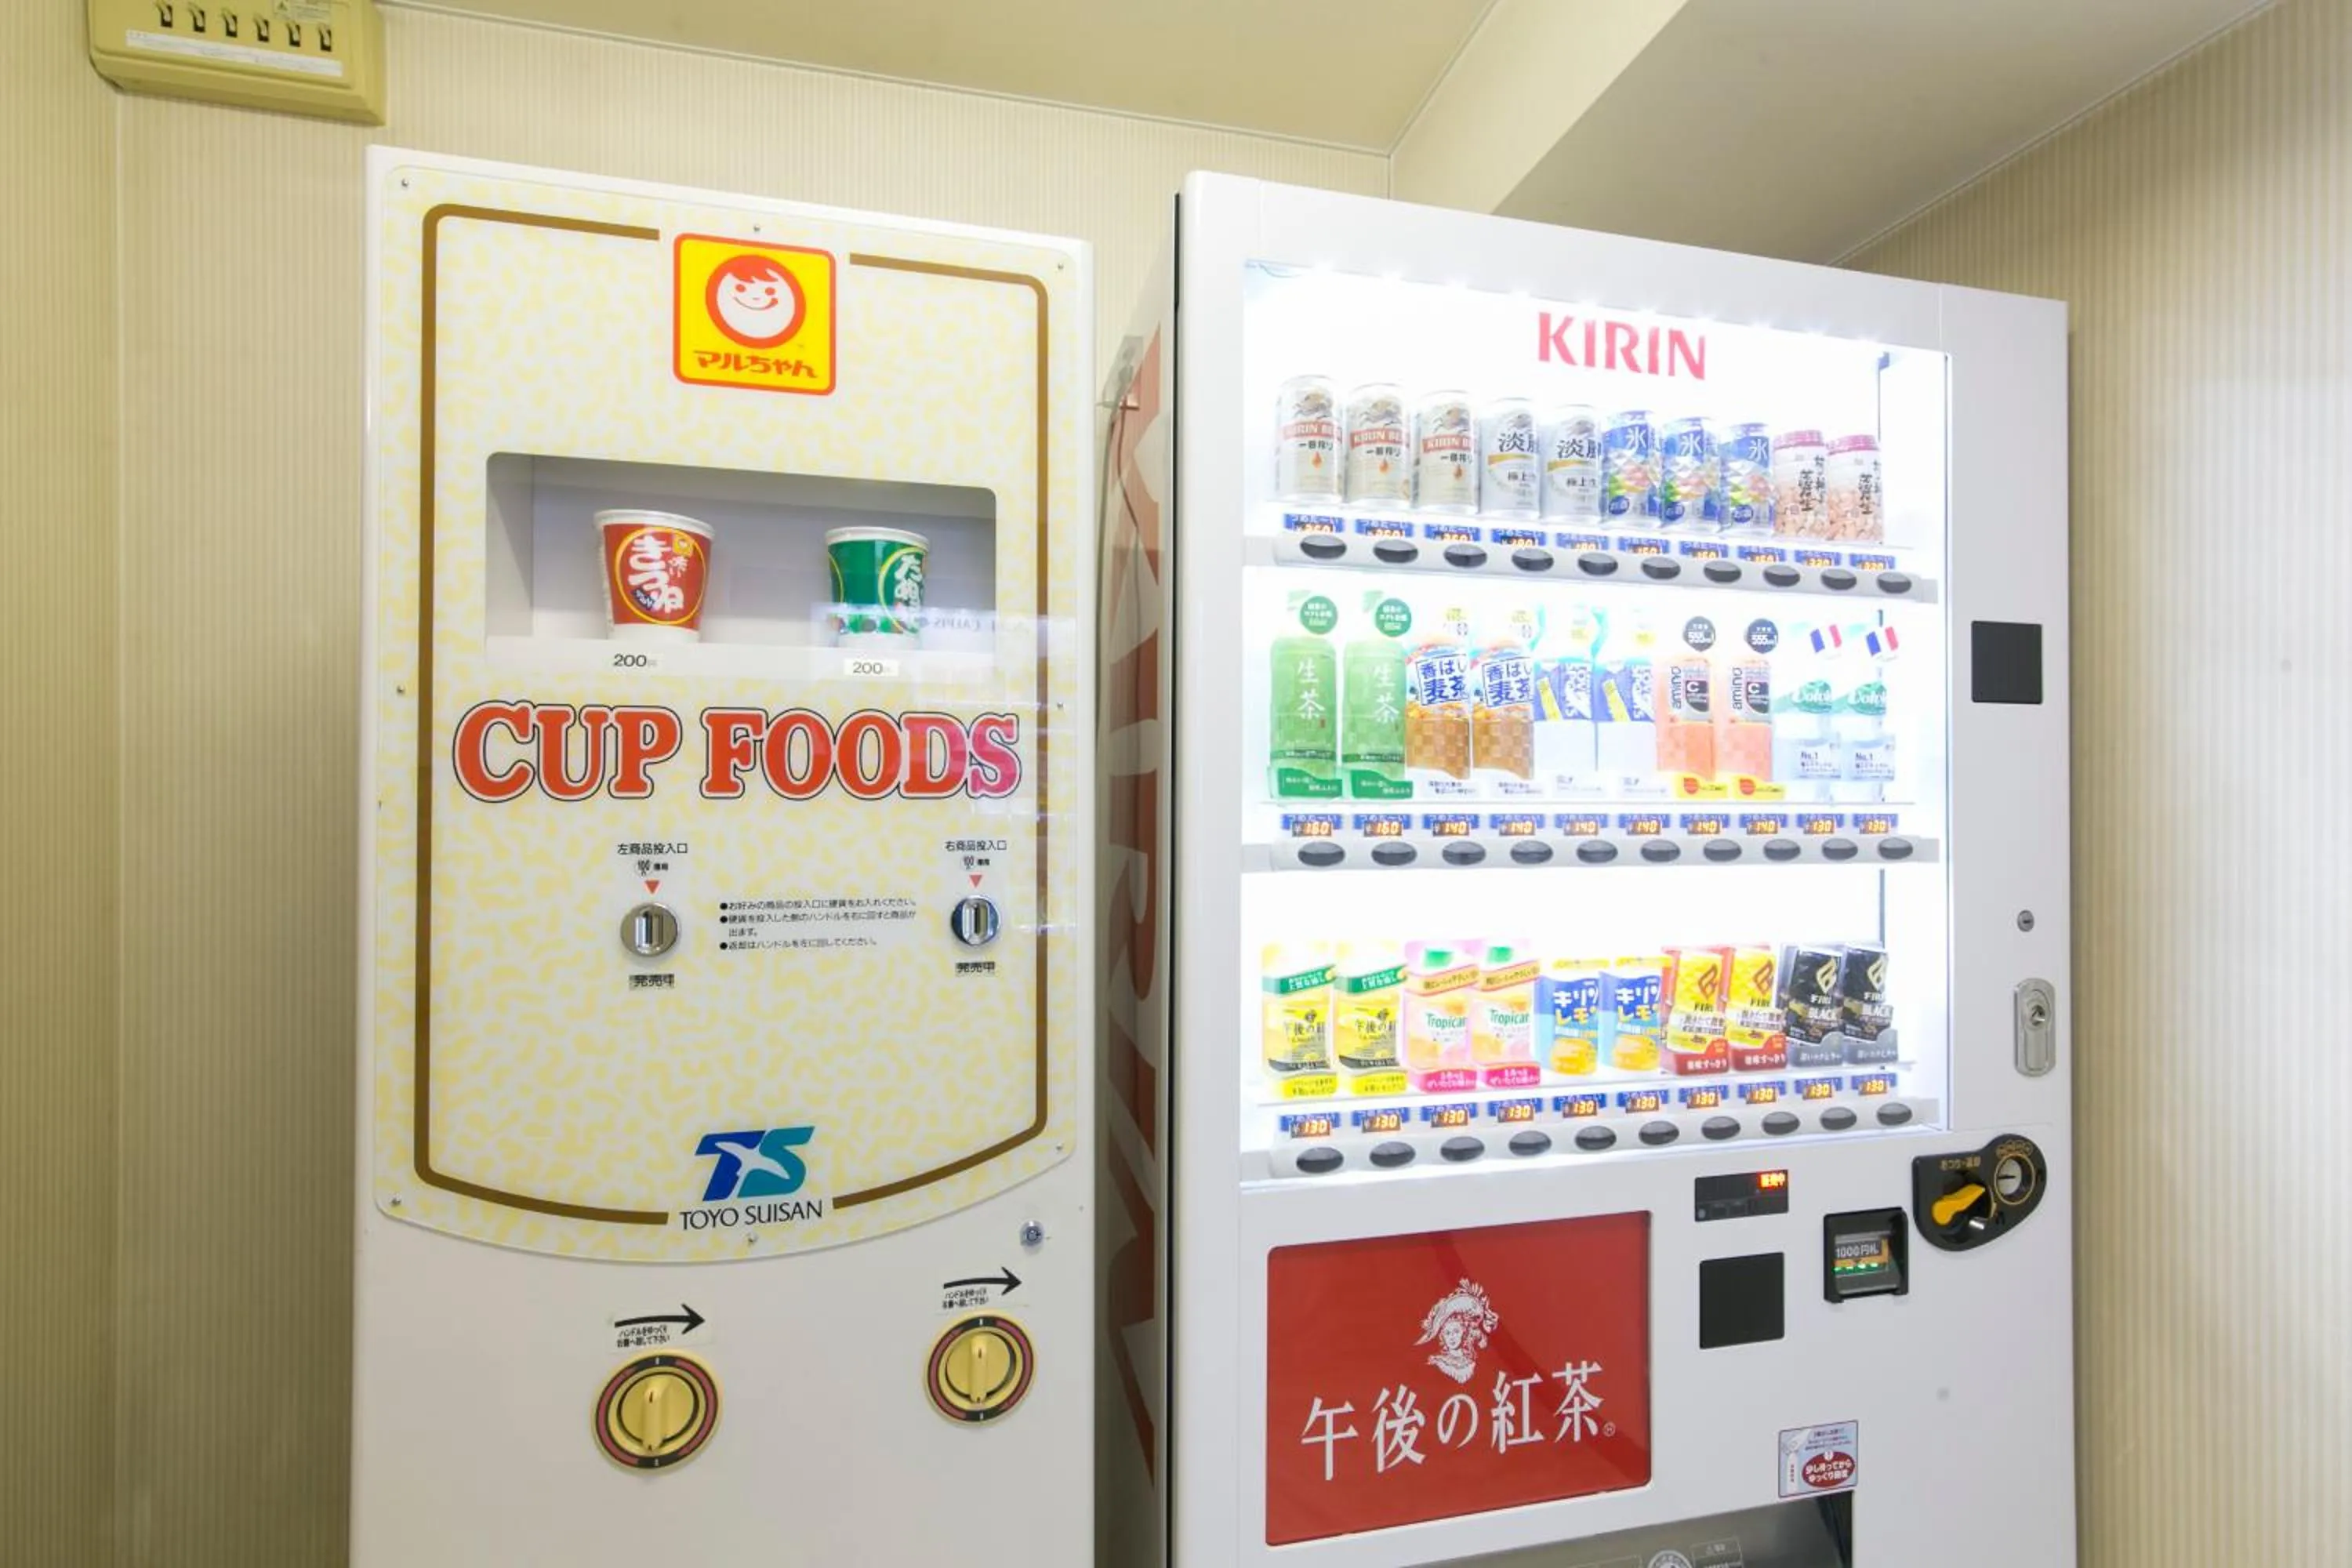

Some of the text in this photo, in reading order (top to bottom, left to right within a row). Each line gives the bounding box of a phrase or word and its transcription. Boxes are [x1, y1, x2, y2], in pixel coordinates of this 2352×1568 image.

[693, 350, 818, 378] マルちゃん
[1538, 312, 1706, 380] KIRIN
[1428, 438, 1461, 448] KIRIN
[628, 535, 684, 614] きつね
[1298, 658, 1325, 720] 生茶
[1374, 663, 1399, 724] 生茶
[1670, 666, 1682, 710] amino
[1686, 681, 1699, 693] C
[1732, 666, 1744, 711] amino
[1748, 683, 1759, 694] C
[452, 699, 1022, 803] CUP FOODS
[617, 843, 688, 855] 左商品投入口
[945, 840, 1007, 851] 右商品投入口
[680, 1200, 822, 1230] TOYO SUISAN
[1836, 1242, 1880, 1258] 1000円札
[1301, 1359, 1605, 1481] 午後の紅茶
